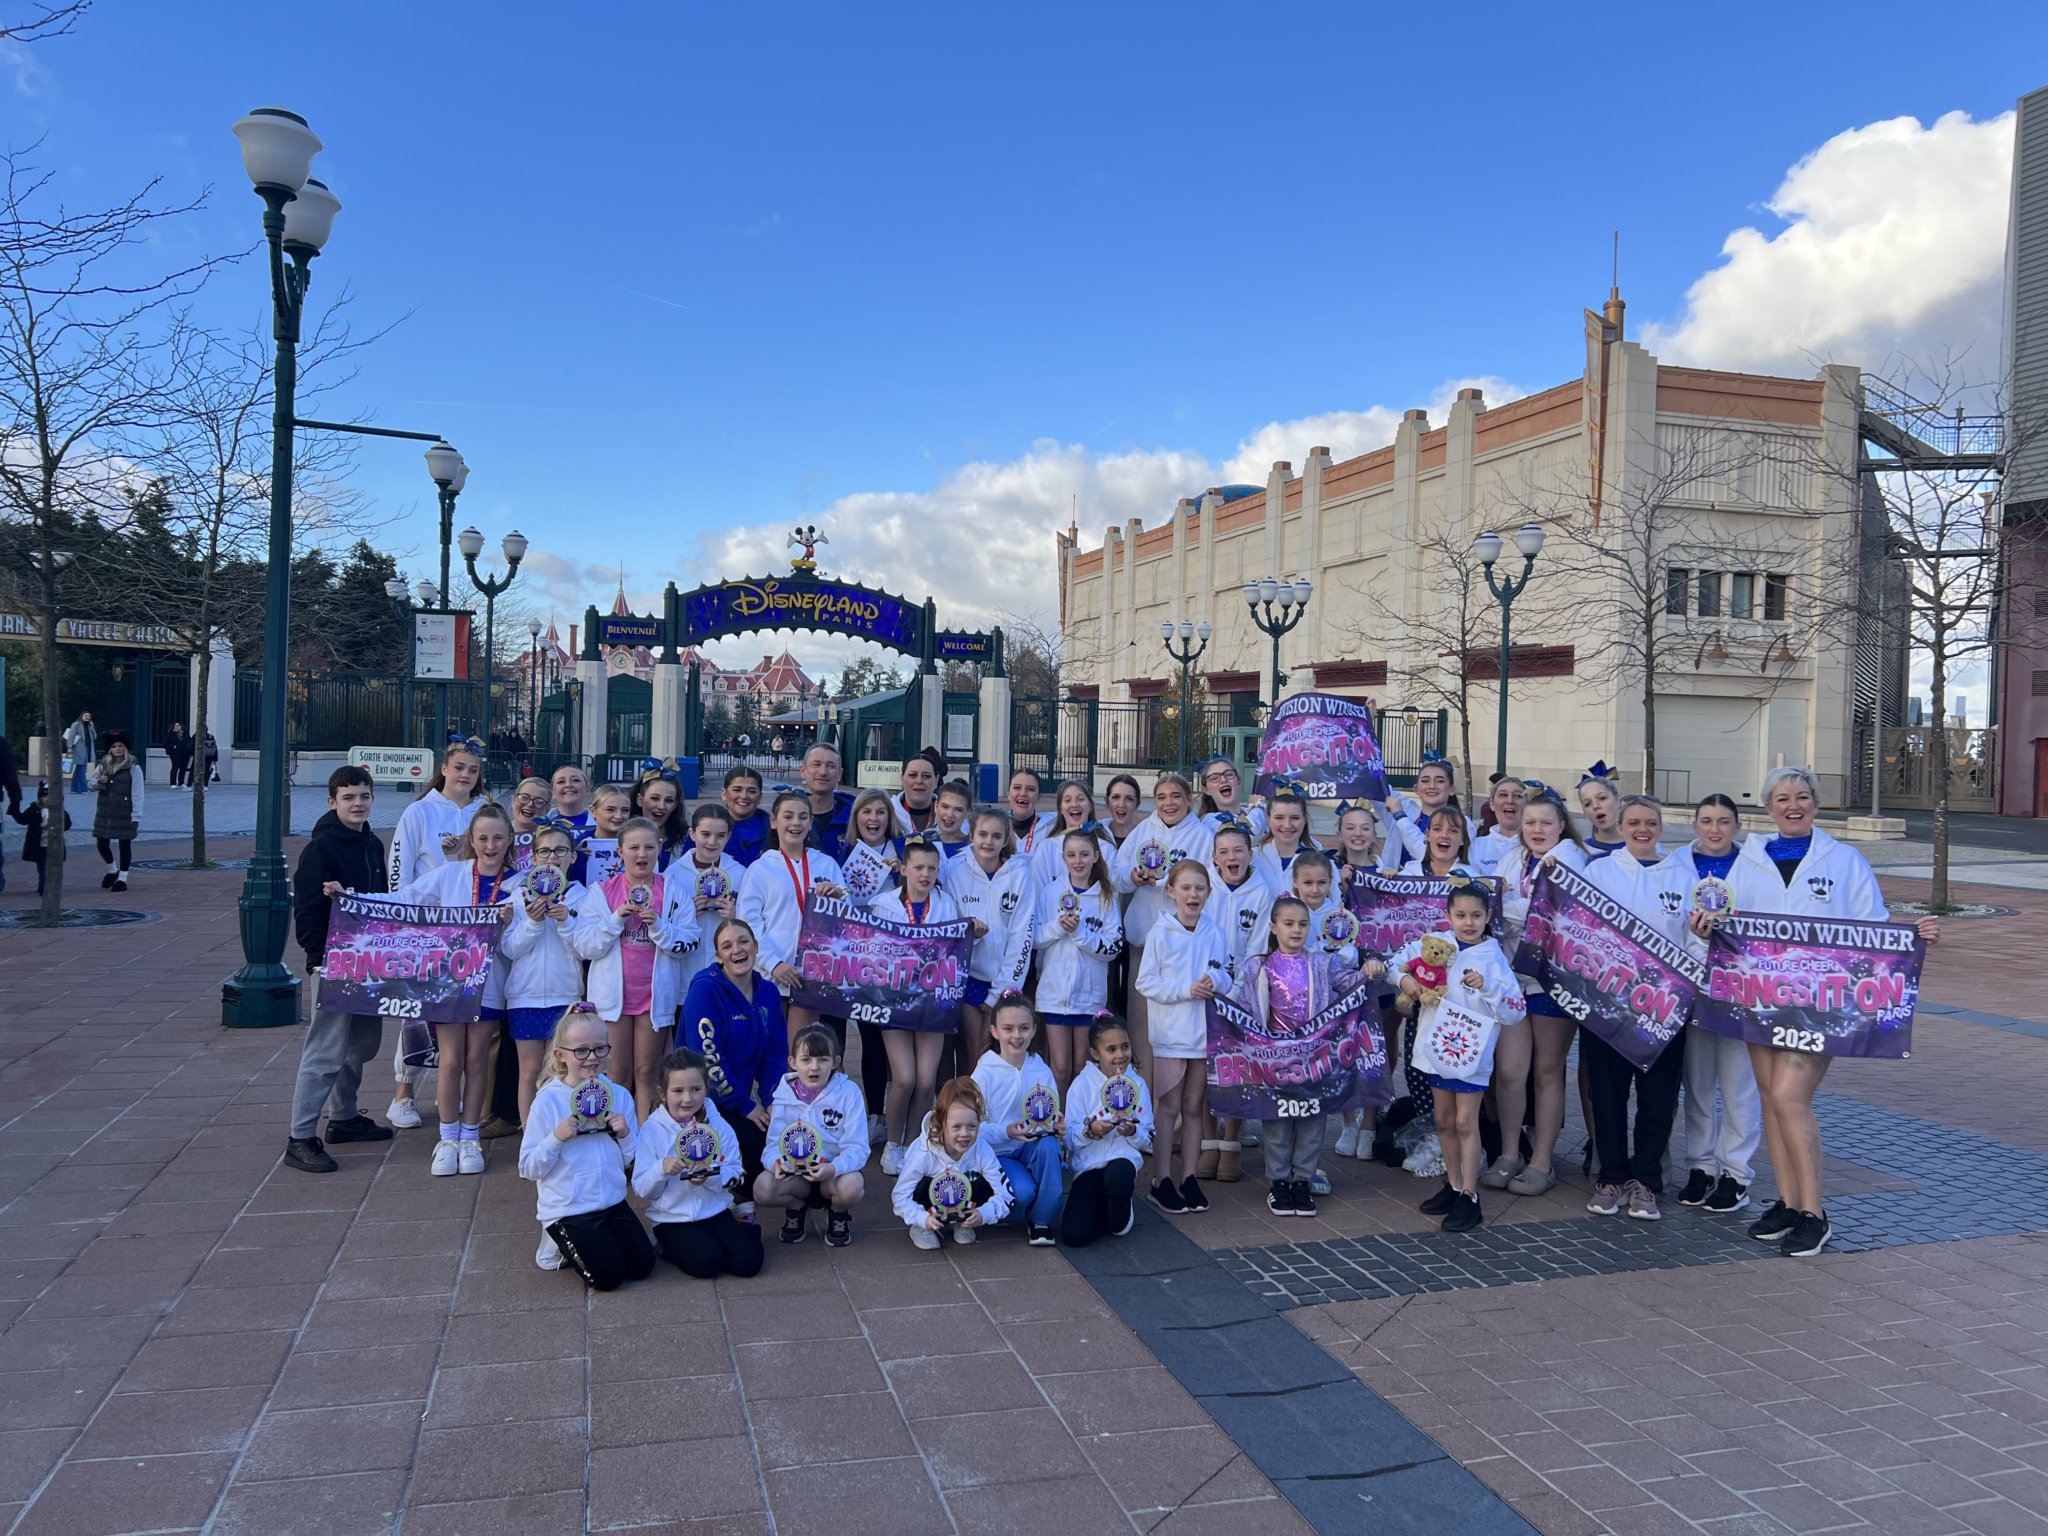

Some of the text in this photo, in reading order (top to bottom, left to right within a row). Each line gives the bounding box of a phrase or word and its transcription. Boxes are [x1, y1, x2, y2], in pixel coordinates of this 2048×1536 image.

[823, 614, 873, 629] PARIS
[607, 626, 657, 636] BIENVENUE
[944, 641, 985, 652] WELCOME
[1287, 725, 1339, 741] FUTURE CHEER
[360, 751, 423, 763] SORTIE UNIQUEMENT
[1329, 737, 1348, 767] IT
[376, 765, 405, 775] EXIT ONLY
[864, 764, 877, 772] CAST
[1304, 782, 1337, 798] 023
[1149, 852, 1156, 867] 1
[541, 877, 550, 893] 1
[708, 880, 716, 895] 1
[1354, 871, 1427, 895] DIVISION
[1706, 891, 1716, 909] 1
[339, 897, 500, 924] DIVISION WINNER
[1390, 909, 1441, 921] FUTURE CHEER
[899, 922, 968, 938] WINNER
[1334, 921, 1343, 937] 1
[1548, 863, 1706, 986] DIVISION WINNER
[372, 936, 439, 948] FUTURE CHEER
[1358, 922, 1428, 953] RINGS
[1568, 924, 1632, 964] FUTURE CHEER
[1813, 923, 1915, 951] WINNER
[850, 942, 910, 954] FUTURE CHEER
[326, 943, 488, 983] BRINGS IT ON
[802, 951, 957, 990] BRINGS IT ON
[1524, 914, 1680, 1027] BRINGS IT ON
[1758, 959, 1834, 972] FUTURE CHEER
[464, 972, 488, 988] PARIS
[935, 986, 965, 1000] PARIS
[1710, 968, 1905, 1013] BRINGS IT ON
[378, 997, 422, 1018] 2023
[1300, 985, 1368, 1035] WINNER
[1550, 983, 1591, 1021] 2023
[850, 1003, 892, 1024] 2023
[1446, 1008, 1482, 1028] 3rd Place
[1876, 1005, 1913, 1022] PARIS
[1636, 1014, 1675, 1041] PARIS
[1772, 1026, 1825, 1052] 2023
[1256, 1041, 1321, 1059] FUTURE CHEER
[1307, 1043, 1333, 1083] IT
[1338, 1021, 1374, 1068] ON
[1356, 1050, 1386, 1070] PARIS
[586, 1093, 596, 1114] 1
[1115, 1089, 1125, 1107] 1
[1035, 1100, 1044, 1118] 1
[1277, 1099, 1321, 1117] 2023
[690, 1139, 702, 1158] 1
[794, 1136, 804, 1156] 1
[944, 1185, 955, 1204] 1
